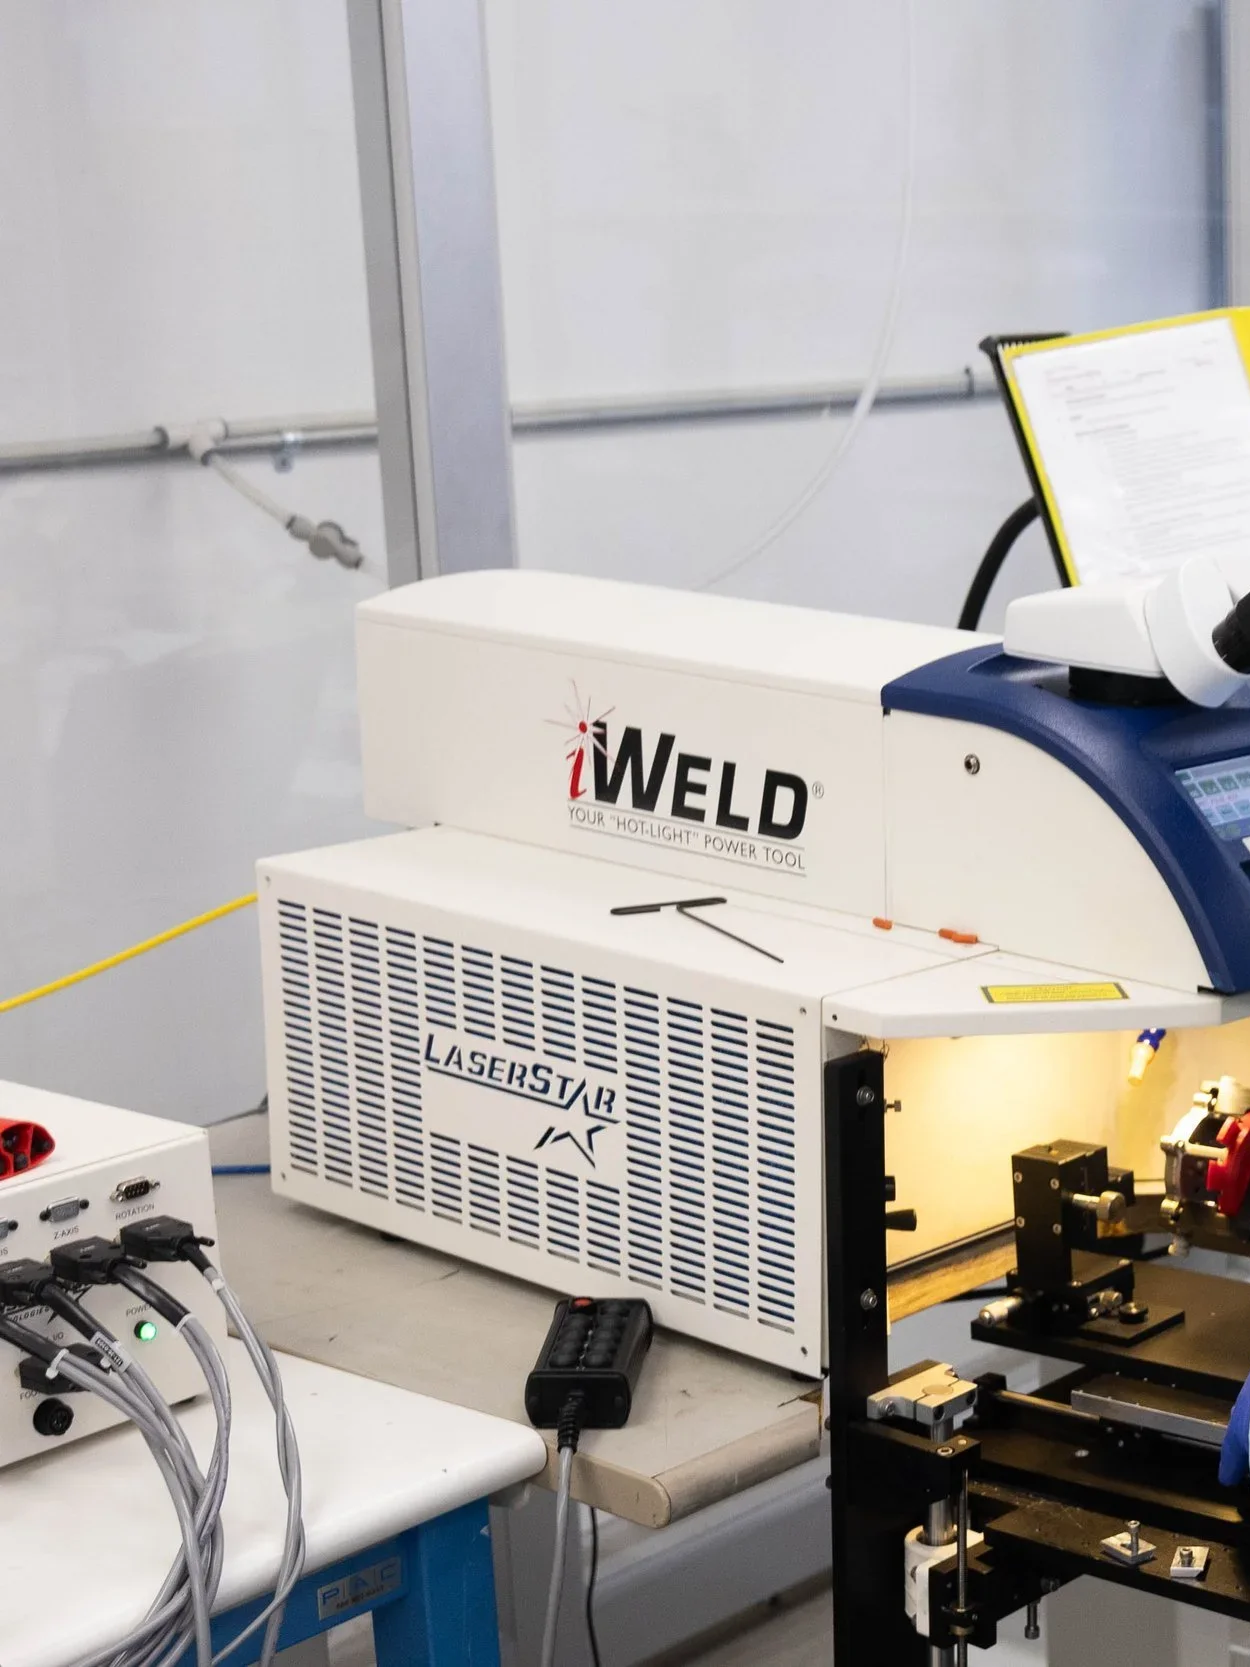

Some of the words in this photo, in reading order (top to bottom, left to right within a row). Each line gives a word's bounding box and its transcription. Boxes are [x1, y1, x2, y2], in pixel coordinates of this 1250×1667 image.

[567, 804, 606, 827] YOUR
[704, 834, 758, 861] POWER
[763, 846, 806, 870] TOOL
[114, 1203, 156, 1221] ROTATION
[53, 1226, 80, 1241] Z-AXIS
